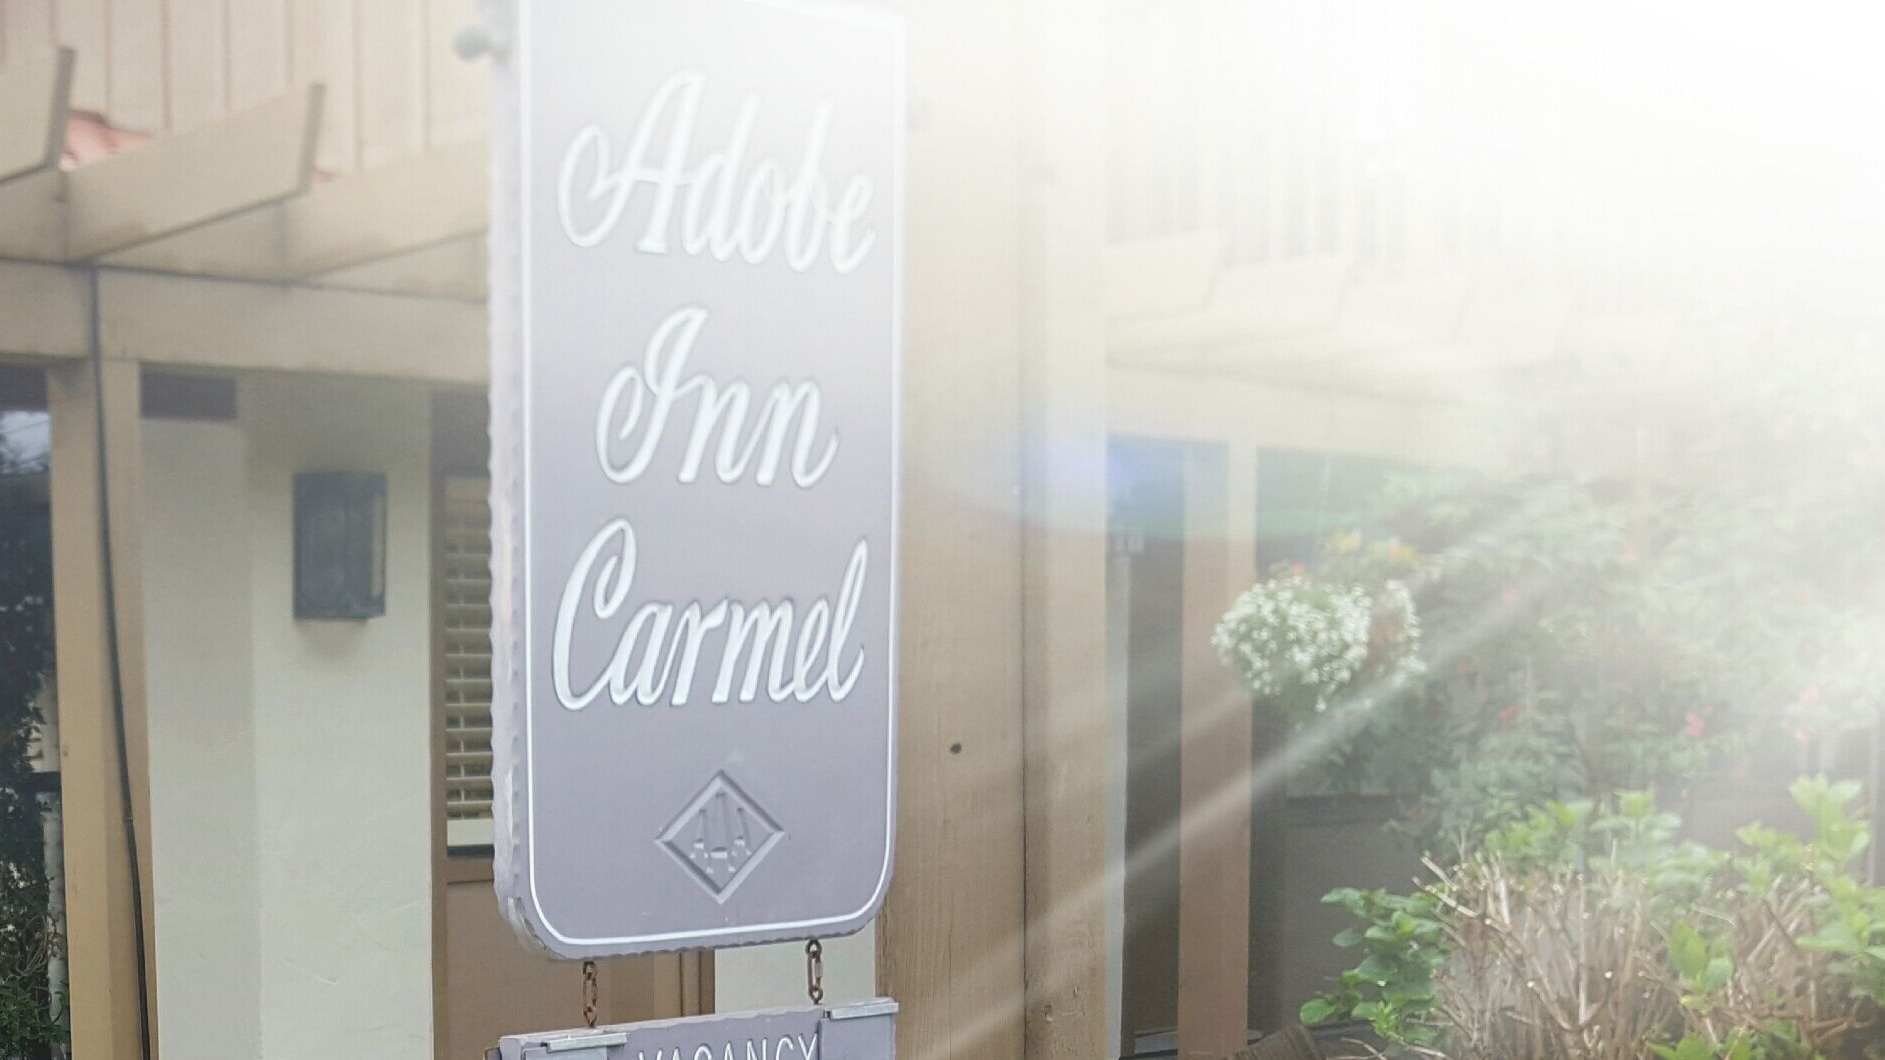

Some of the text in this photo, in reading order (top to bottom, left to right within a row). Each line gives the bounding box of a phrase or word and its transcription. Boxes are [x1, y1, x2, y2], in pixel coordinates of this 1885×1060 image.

[557, 69, 876, 274] Adobe
[596, 307, 840, 488] Inn
[552, 517, 869, 711] Carmel
